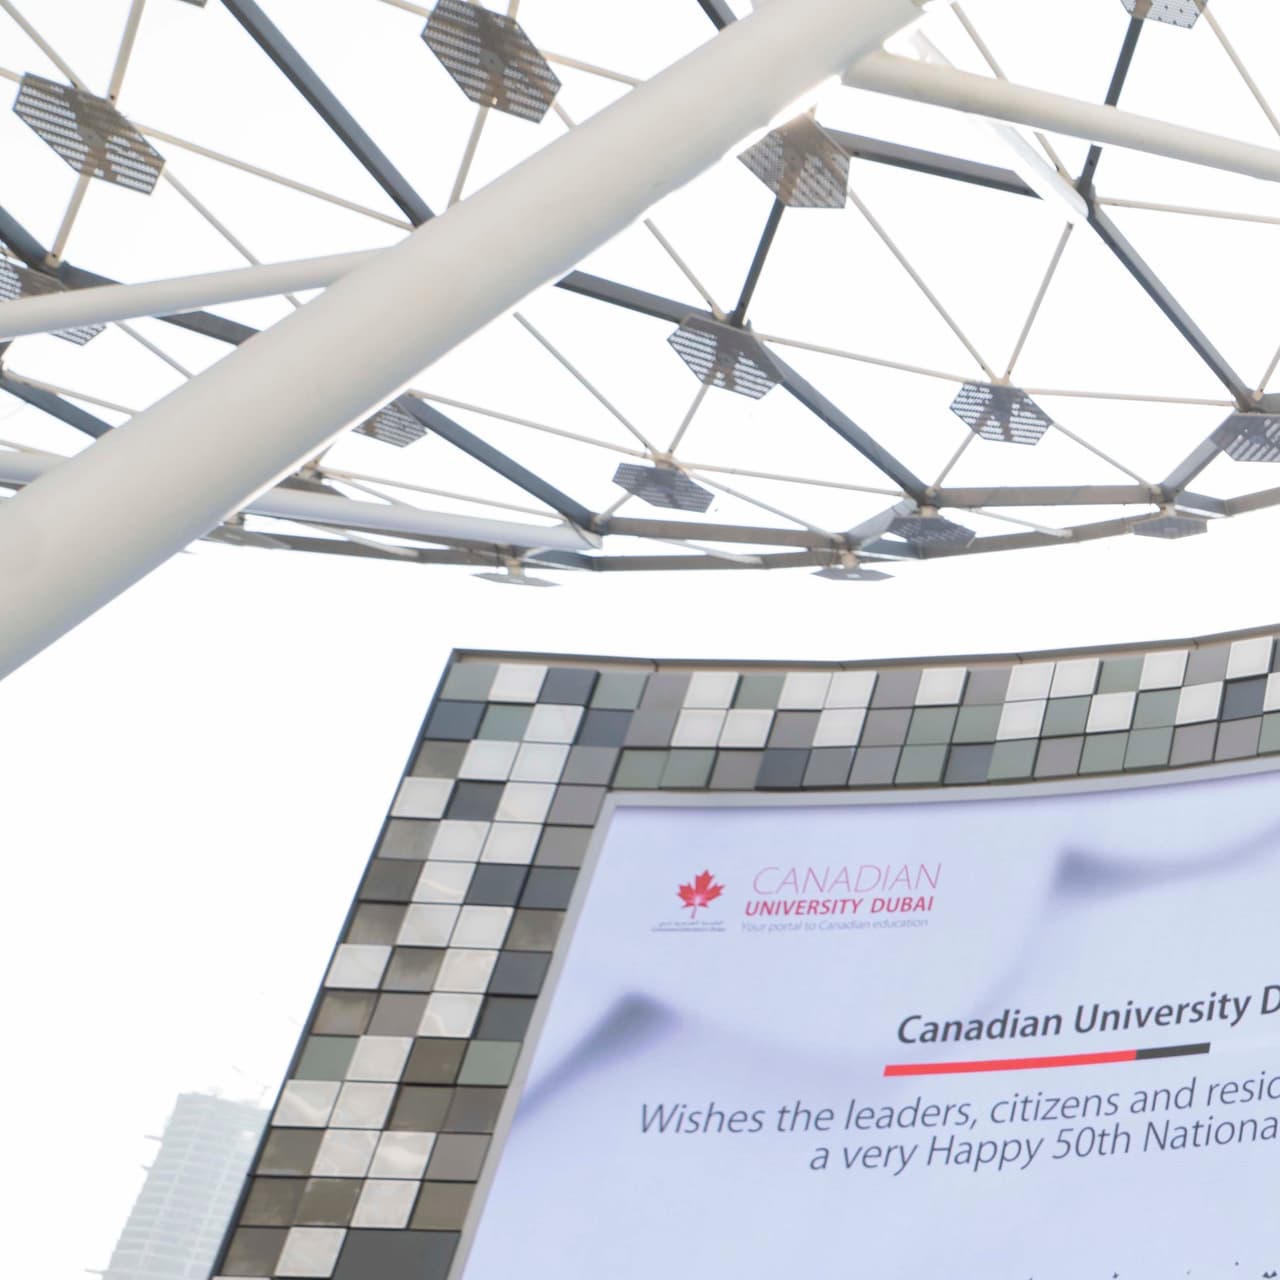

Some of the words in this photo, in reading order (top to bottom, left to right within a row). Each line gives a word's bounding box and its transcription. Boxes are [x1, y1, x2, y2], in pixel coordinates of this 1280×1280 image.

[753, 863, 942, 895] CANADIAN
[740, 920, 766, 933] Your
[768, 920, 802, 934] portal
[804, 920, 817, 931] to
[819, 919, 871, 931] Canadian
[872, 917, 929, 929] education
[744, 898, 863, 917] UNIVERSITY
[869, 896, 934, 913] DUBAI
[897, 1008, 1064, 1044] Canadian
[1074, 992, 1252, 1034] University
[640, 1102, 766, 1134] Wishes
[776, 1100, 836, 1131] the
[844, 1098, 978, 1130] leaders,
[989, 1091, 1119, 1124] citizens
[1130, 1076, 1197, 1115] and
[808, 1146, 830, 1171] a
[842, 1141, 919, 1176] very
[926, 1134, 1044, 1172] Happy
[1052, 1119, 1131, 1160] 50th
